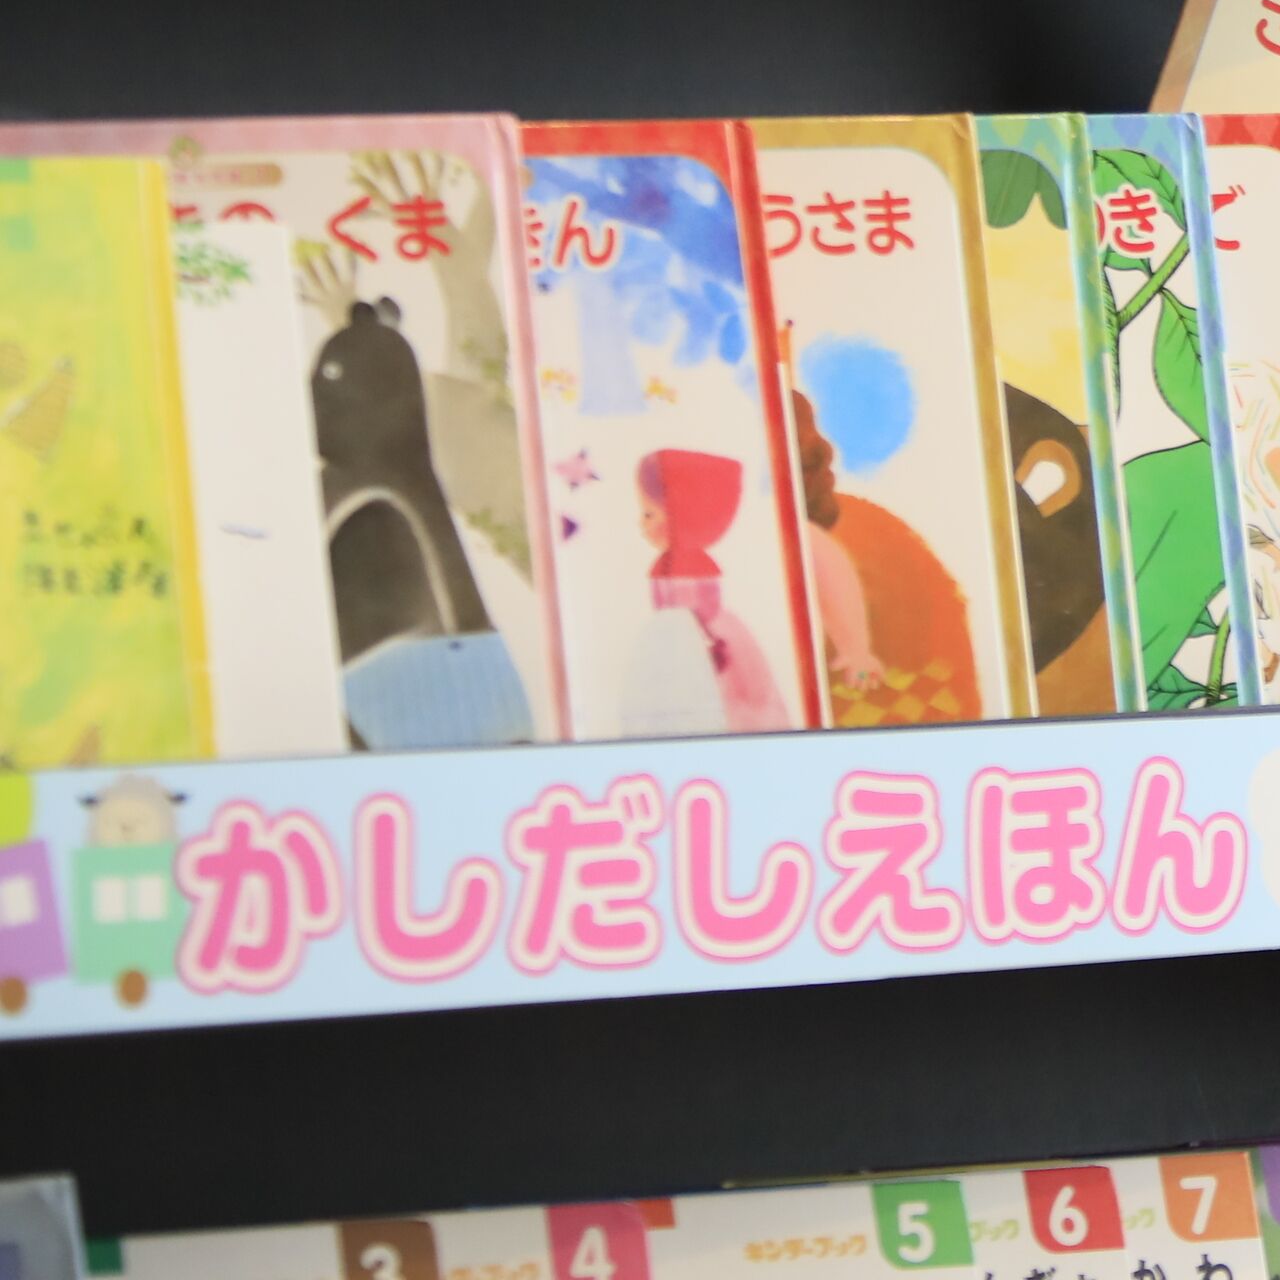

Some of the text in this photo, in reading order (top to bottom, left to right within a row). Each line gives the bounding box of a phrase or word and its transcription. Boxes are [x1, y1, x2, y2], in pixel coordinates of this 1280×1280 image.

[328, 195, 451, 262] くま
[762, 189, 915, 257] うさま
[178, 756, 1248, 993] かしだしえほん
[897, 1201, 936, 1264] 5
[1048, 1185, 1090, 1247] 6
[1179, 1175, 1219, 1236] 7
[569, 1225, 617, 1280] 4
